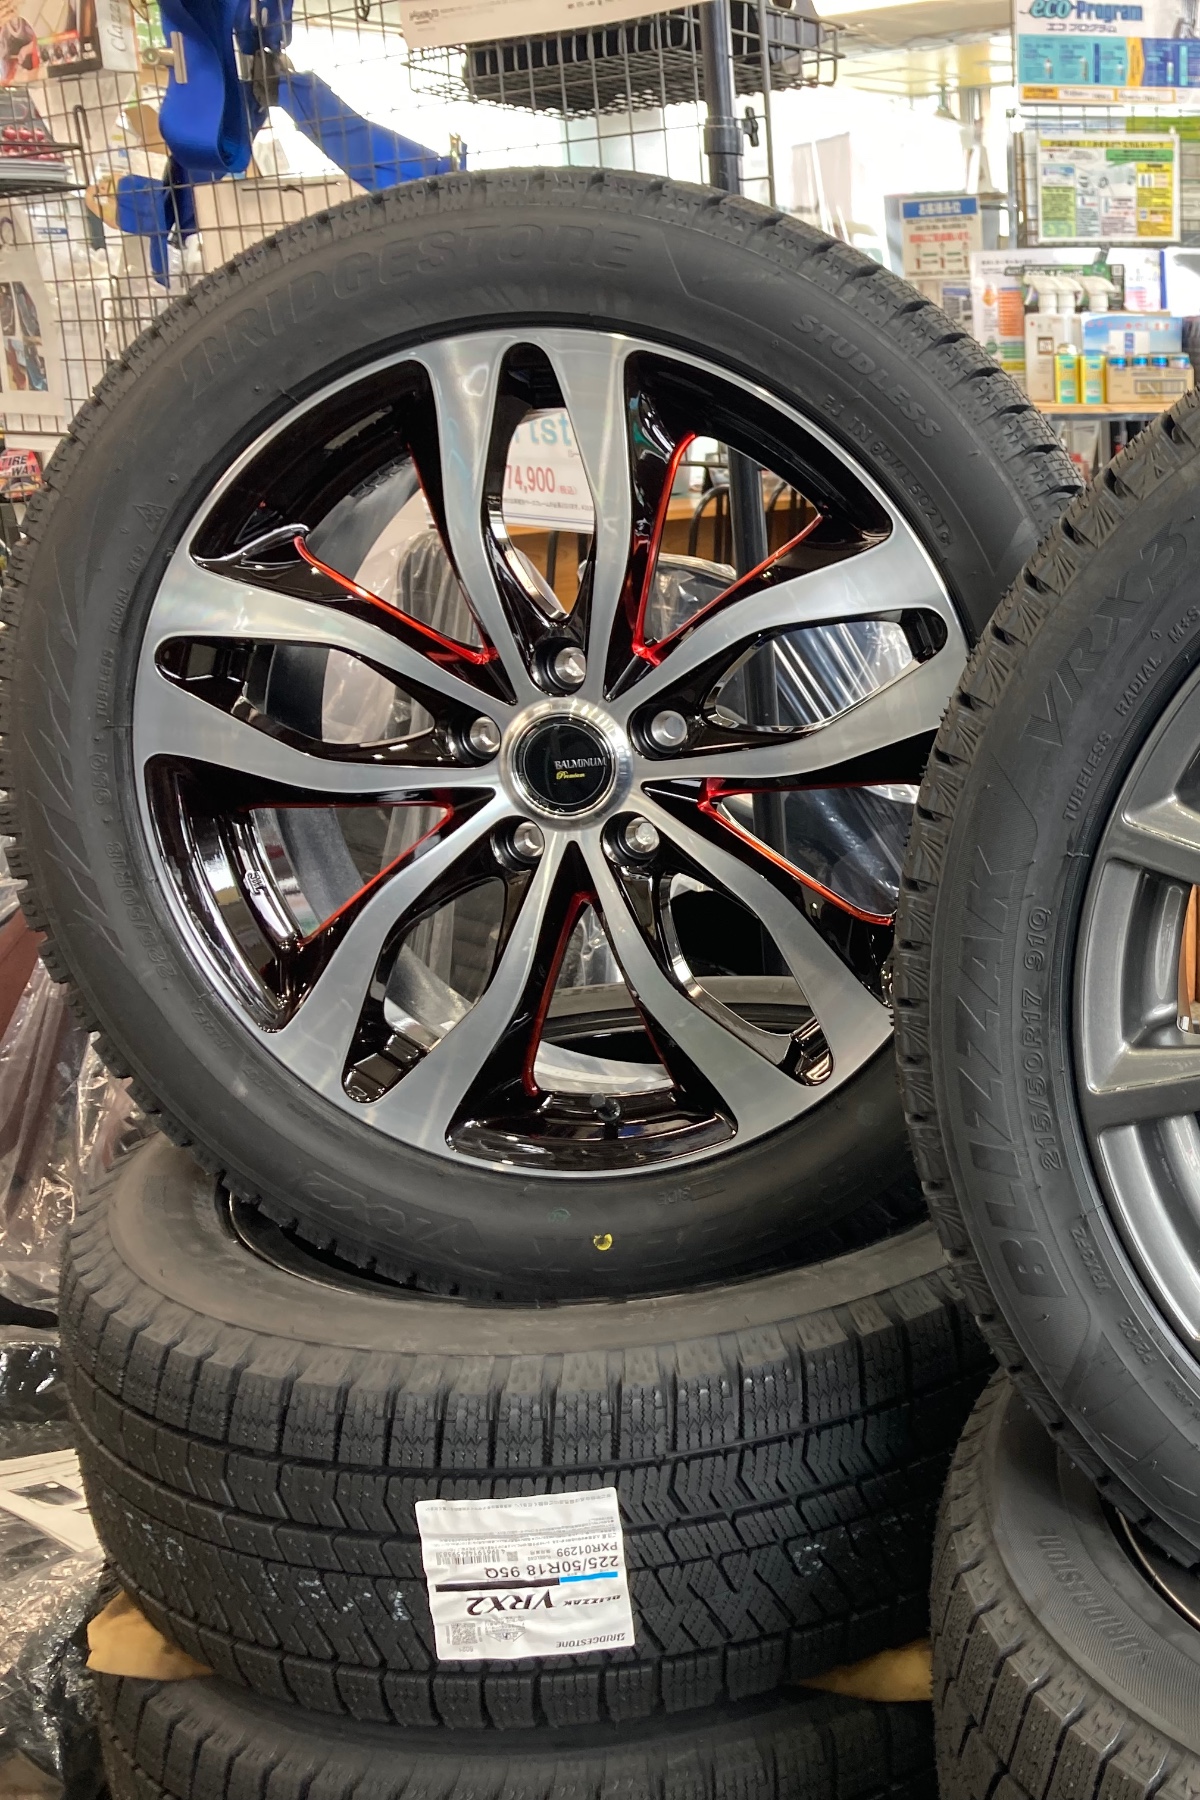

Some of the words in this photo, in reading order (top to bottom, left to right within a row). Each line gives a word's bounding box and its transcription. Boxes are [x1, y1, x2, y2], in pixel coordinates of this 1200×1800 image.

[180, 223, 643, 400] BRIDGESTONE
[791, 313, 942, 439] STUDLESS
[1018, 520, 1188, 747] VRX3
[554, 757, 607, 770] BALMINUM
[1063, 729, 1113, 822] TUBELESS
[1114, 655, 1162, 717] RADIAL
[1024, 905, 1053, 971] 91Q
[955, 844, 1068, 1298] BLIZZAK
[1022, 988, 1065, 1172] 215/50R17
[484, 1566, 521, 1579] 95Q
[526, 1555, 619, 1578] 225/50R18
[556, 1541, 618, 1558] PXR01299
[466, 1592, 555, 1616] VRX2
[556, 1632, 626, 1649] BRIDGESTONE
